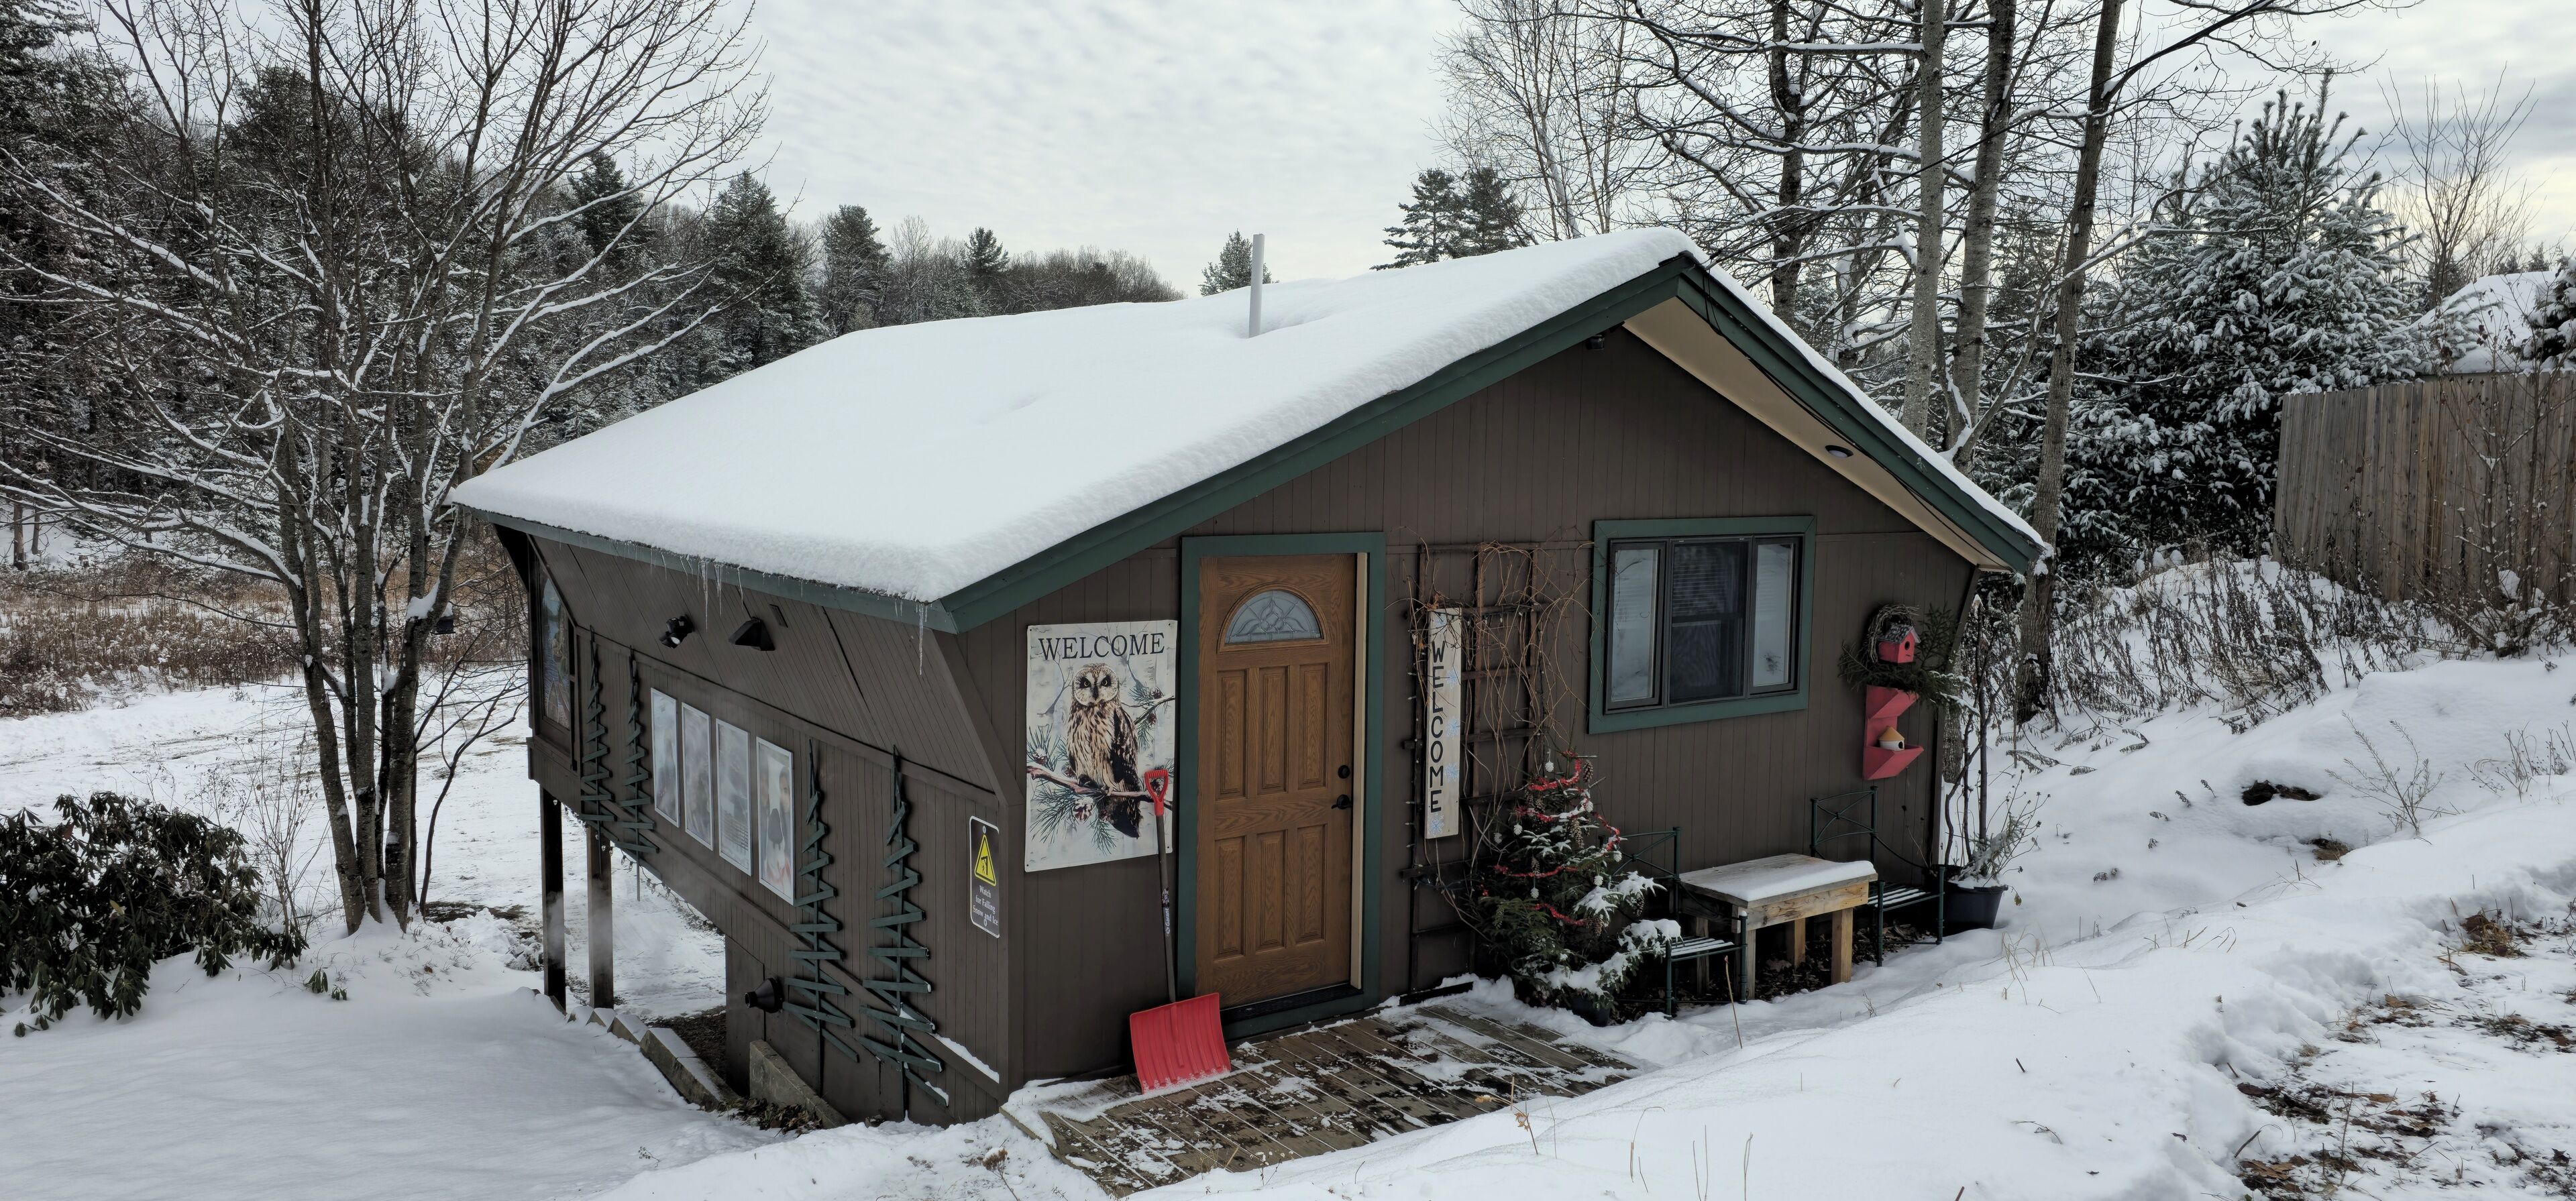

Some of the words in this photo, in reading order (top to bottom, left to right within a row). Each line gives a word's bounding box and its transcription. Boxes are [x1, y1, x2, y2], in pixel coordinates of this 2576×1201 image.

[1038, 632, 1165, 661] WELCOME
[1429, 640, 1445, 813] WELCOME
[979, 885, 991, 899] Watch
[973, 905, 983, 917] Snow
[984, 913, 992, 922] and
[982, 899, 996, 915] Falling
